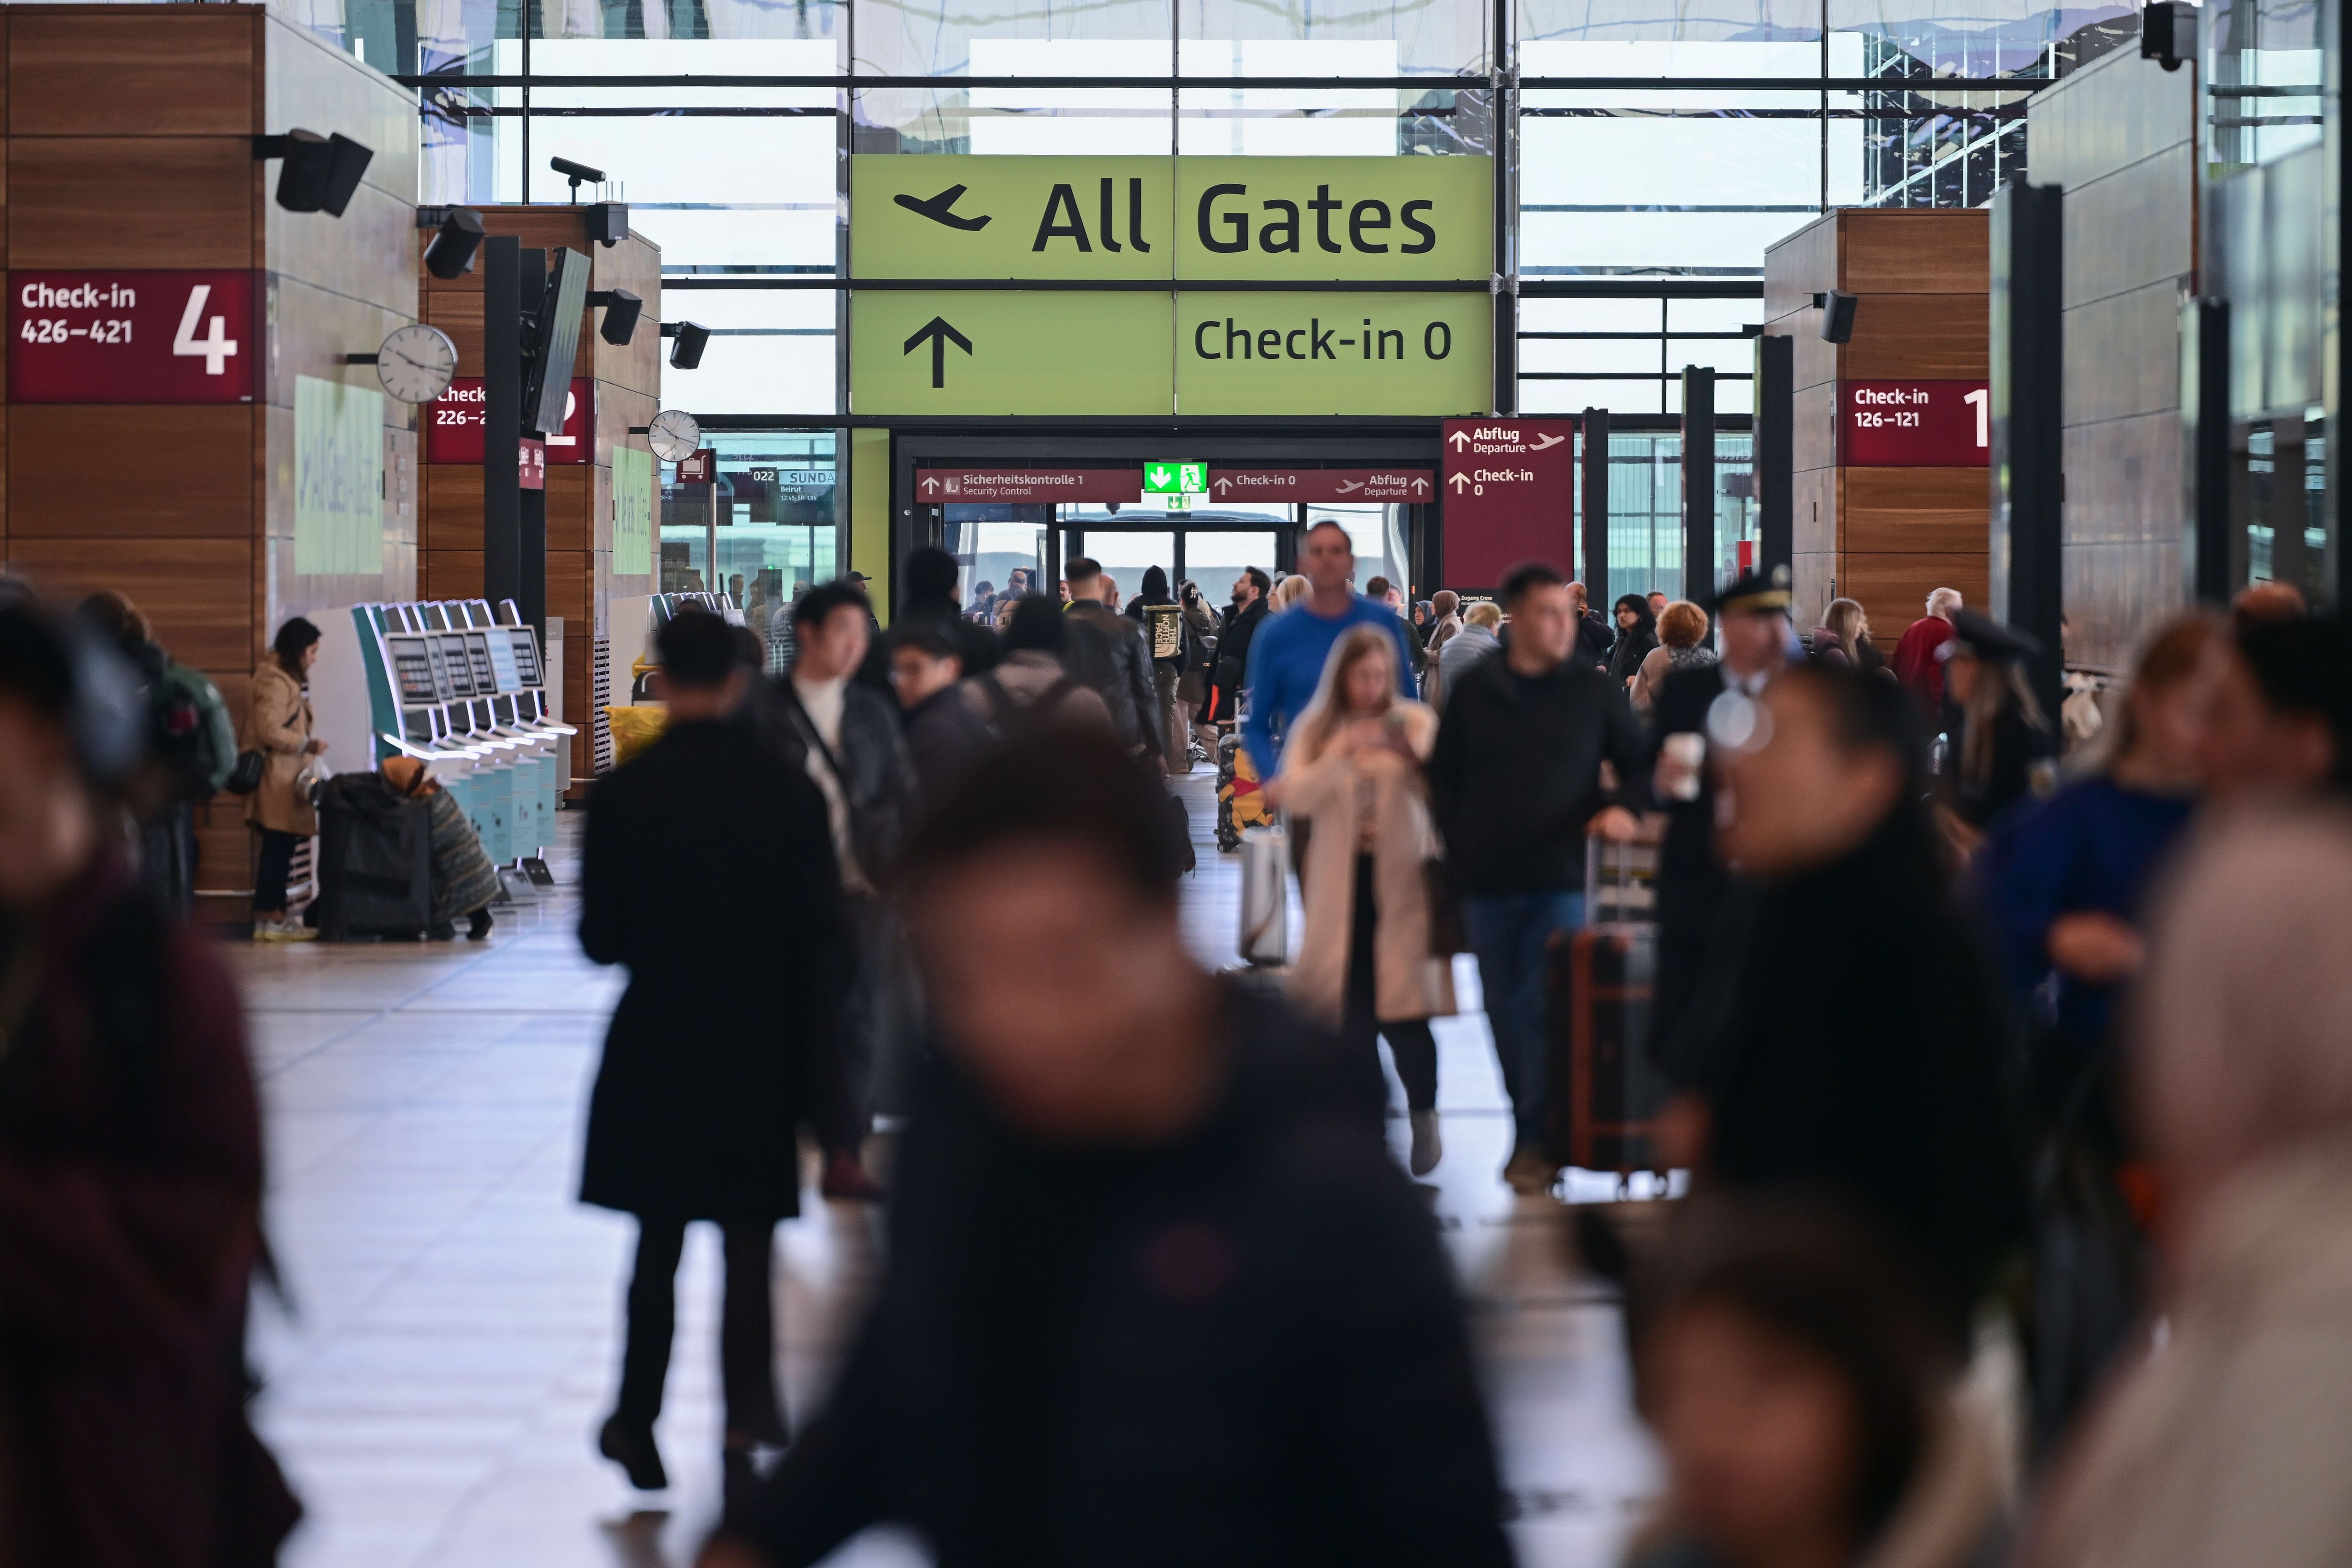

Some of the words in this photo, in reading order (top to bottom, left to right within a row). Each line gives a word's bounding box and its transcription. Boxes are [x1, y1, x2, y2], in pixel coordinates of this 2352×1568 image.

[1031, 178, 1151, 253] All
[1197, 183, 1436, 254] Gates
[21, 282, 136, 308] Check-in
[21, 319, 131, 343] 426–421
[173, 285, 237, 375] 4
[1195, 318, 1403, 360] Check-in
[1424, 321, 1451, 360] 0
[1855, 388, 1929, 405] Check-in
[1855, 412, 1919, 428] 126–121
[1964, 389, 1988, 447] 1
[1473, 427, 1520, 443] Abflug
[1474, 443, 1526, 455] Departure
[753, 471, 774, 481] 022
[963, 474, 1074, 485] Sicherheitskontrolle
[1078, 474, 1083, 485] 1
[1237, 475, 1285, 485] Check-in
[1288, 475, 1296, 485] 0
[1369, 474, 1406, 487] Abflug
[1474, 469, 1533, 481] Check-in
[963, 487, 997, 497] Security
[1000, 487, 1031, 495] Control
[1365, 488, 1407, 497] Departure
[1474, 485, 1483, 496] 0
[1155, 622, 1163, 644] FACE
[1162, 614, 1170, 644] NORTH
